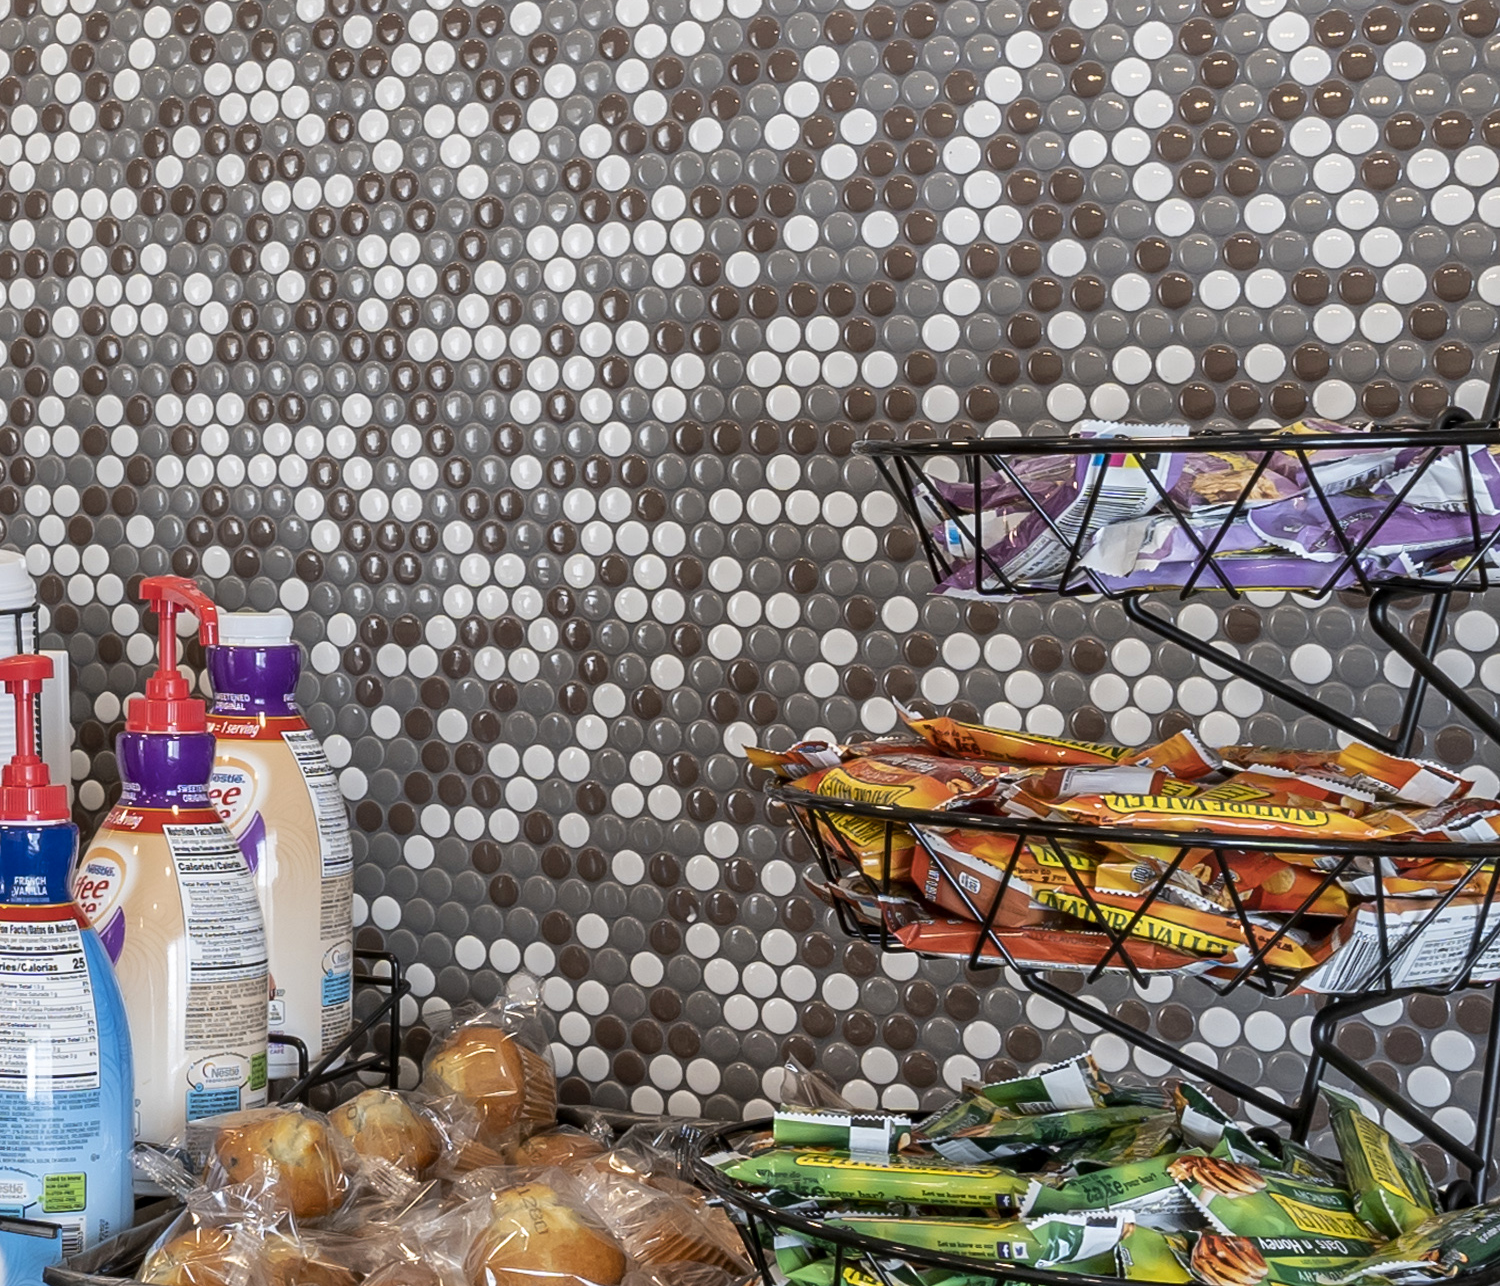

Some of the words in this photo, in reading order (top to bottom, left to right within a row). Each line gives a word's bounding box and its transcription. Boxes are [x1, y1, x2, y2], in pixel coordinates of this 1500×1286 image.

[226, 722, 260, 738] serving
[1212, 800, 1318, 821] NATURE
[167, 827, 195, 836] Nutrition
[14, 876, 47, 885] FRENCH
[13, 886, 48, 896] VANILLA
[72, 957, 86, 969] 25
[1257, 1236, 1306, 1255] Honey
[1314, 1238, 1349, 1255] Oats
